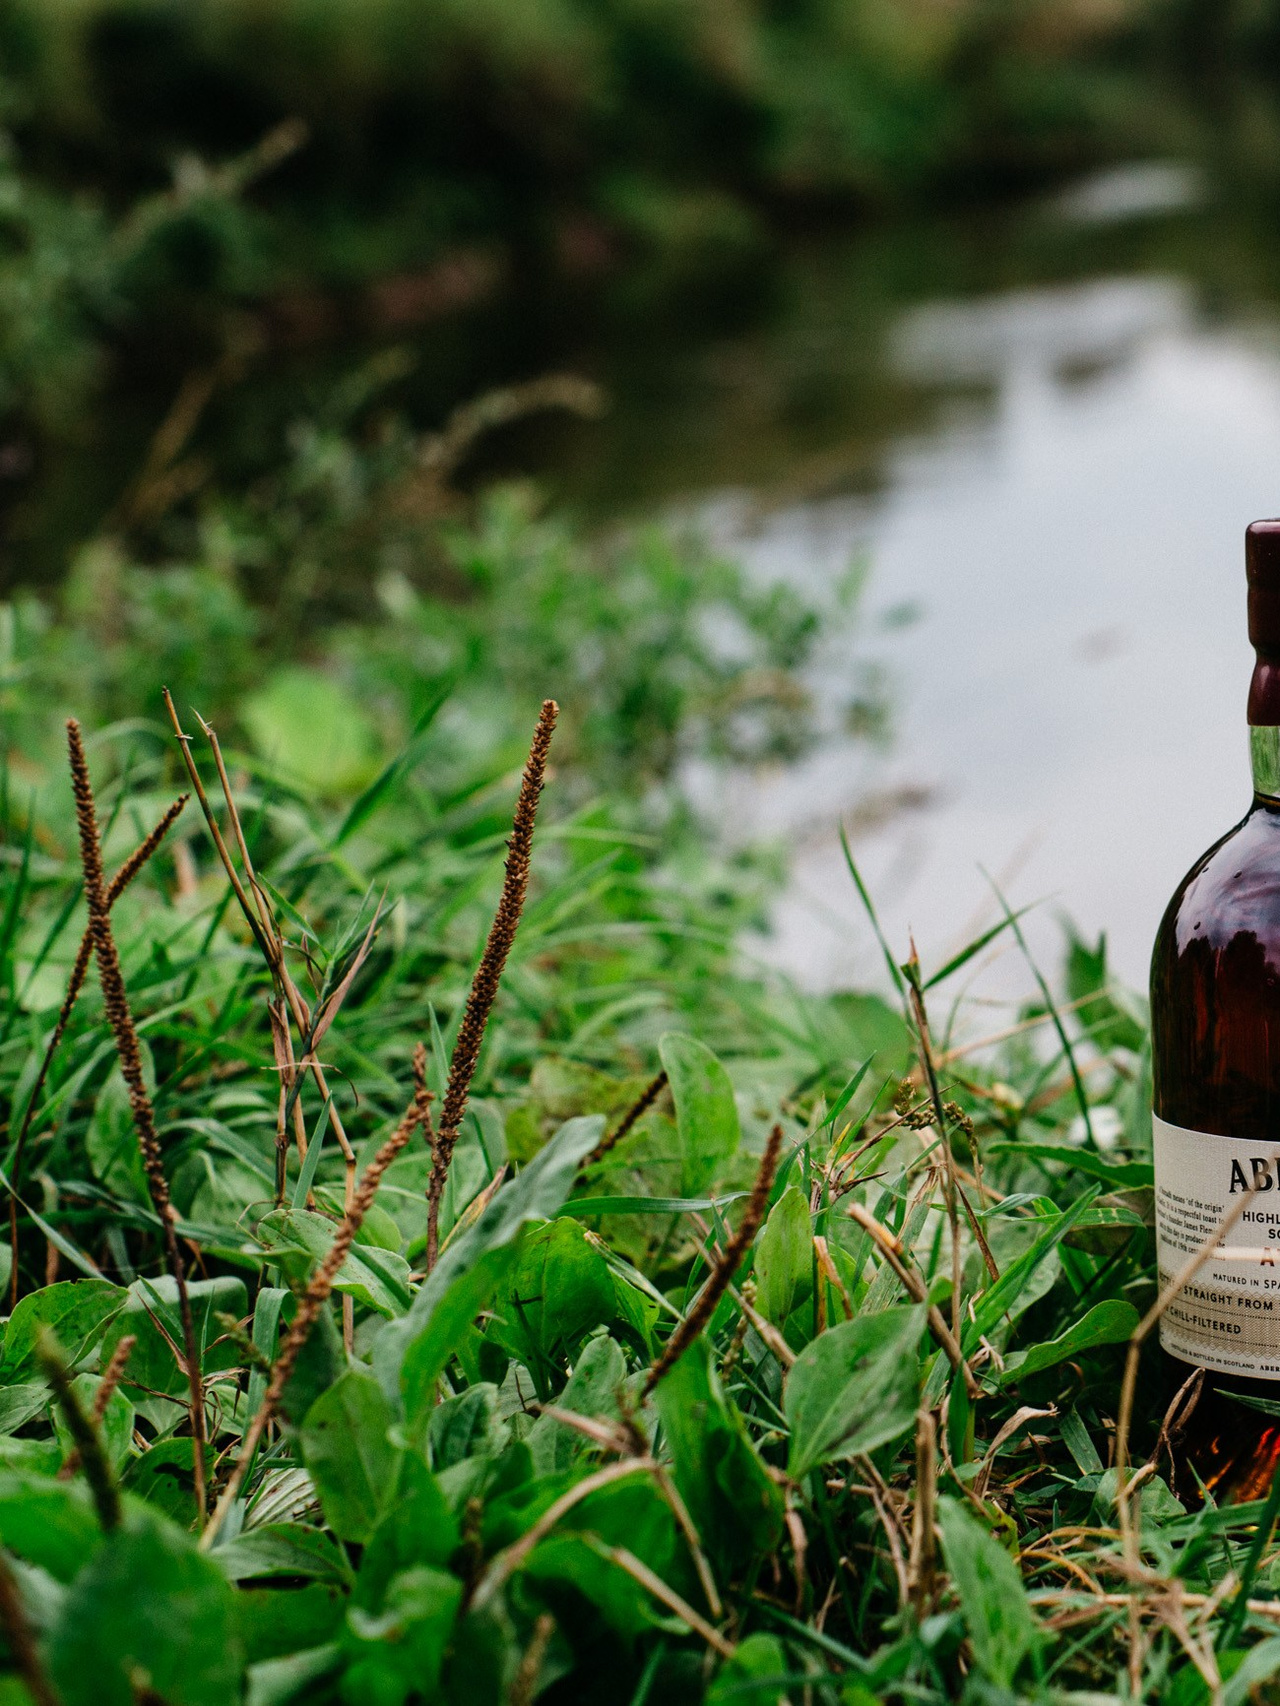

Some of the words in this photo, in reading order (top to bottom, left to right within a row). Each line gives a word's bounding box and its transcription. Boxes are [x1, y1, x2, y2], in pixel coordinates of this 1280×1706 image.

[1202, 1214, 1217, 1224] toast
[1213, 1273, 1247, 1285] MATURED
[1250, 1279, 1259, 1287] IN
[1184, 1285, 1233, 1305] STRAIGHT
[1238, 1298, 1273, 1311] FROM
[1170, 1306, 1241, 1334] CHILL-FILTERED
[1223, 1360, 1255, 1370] SCOTLAND
